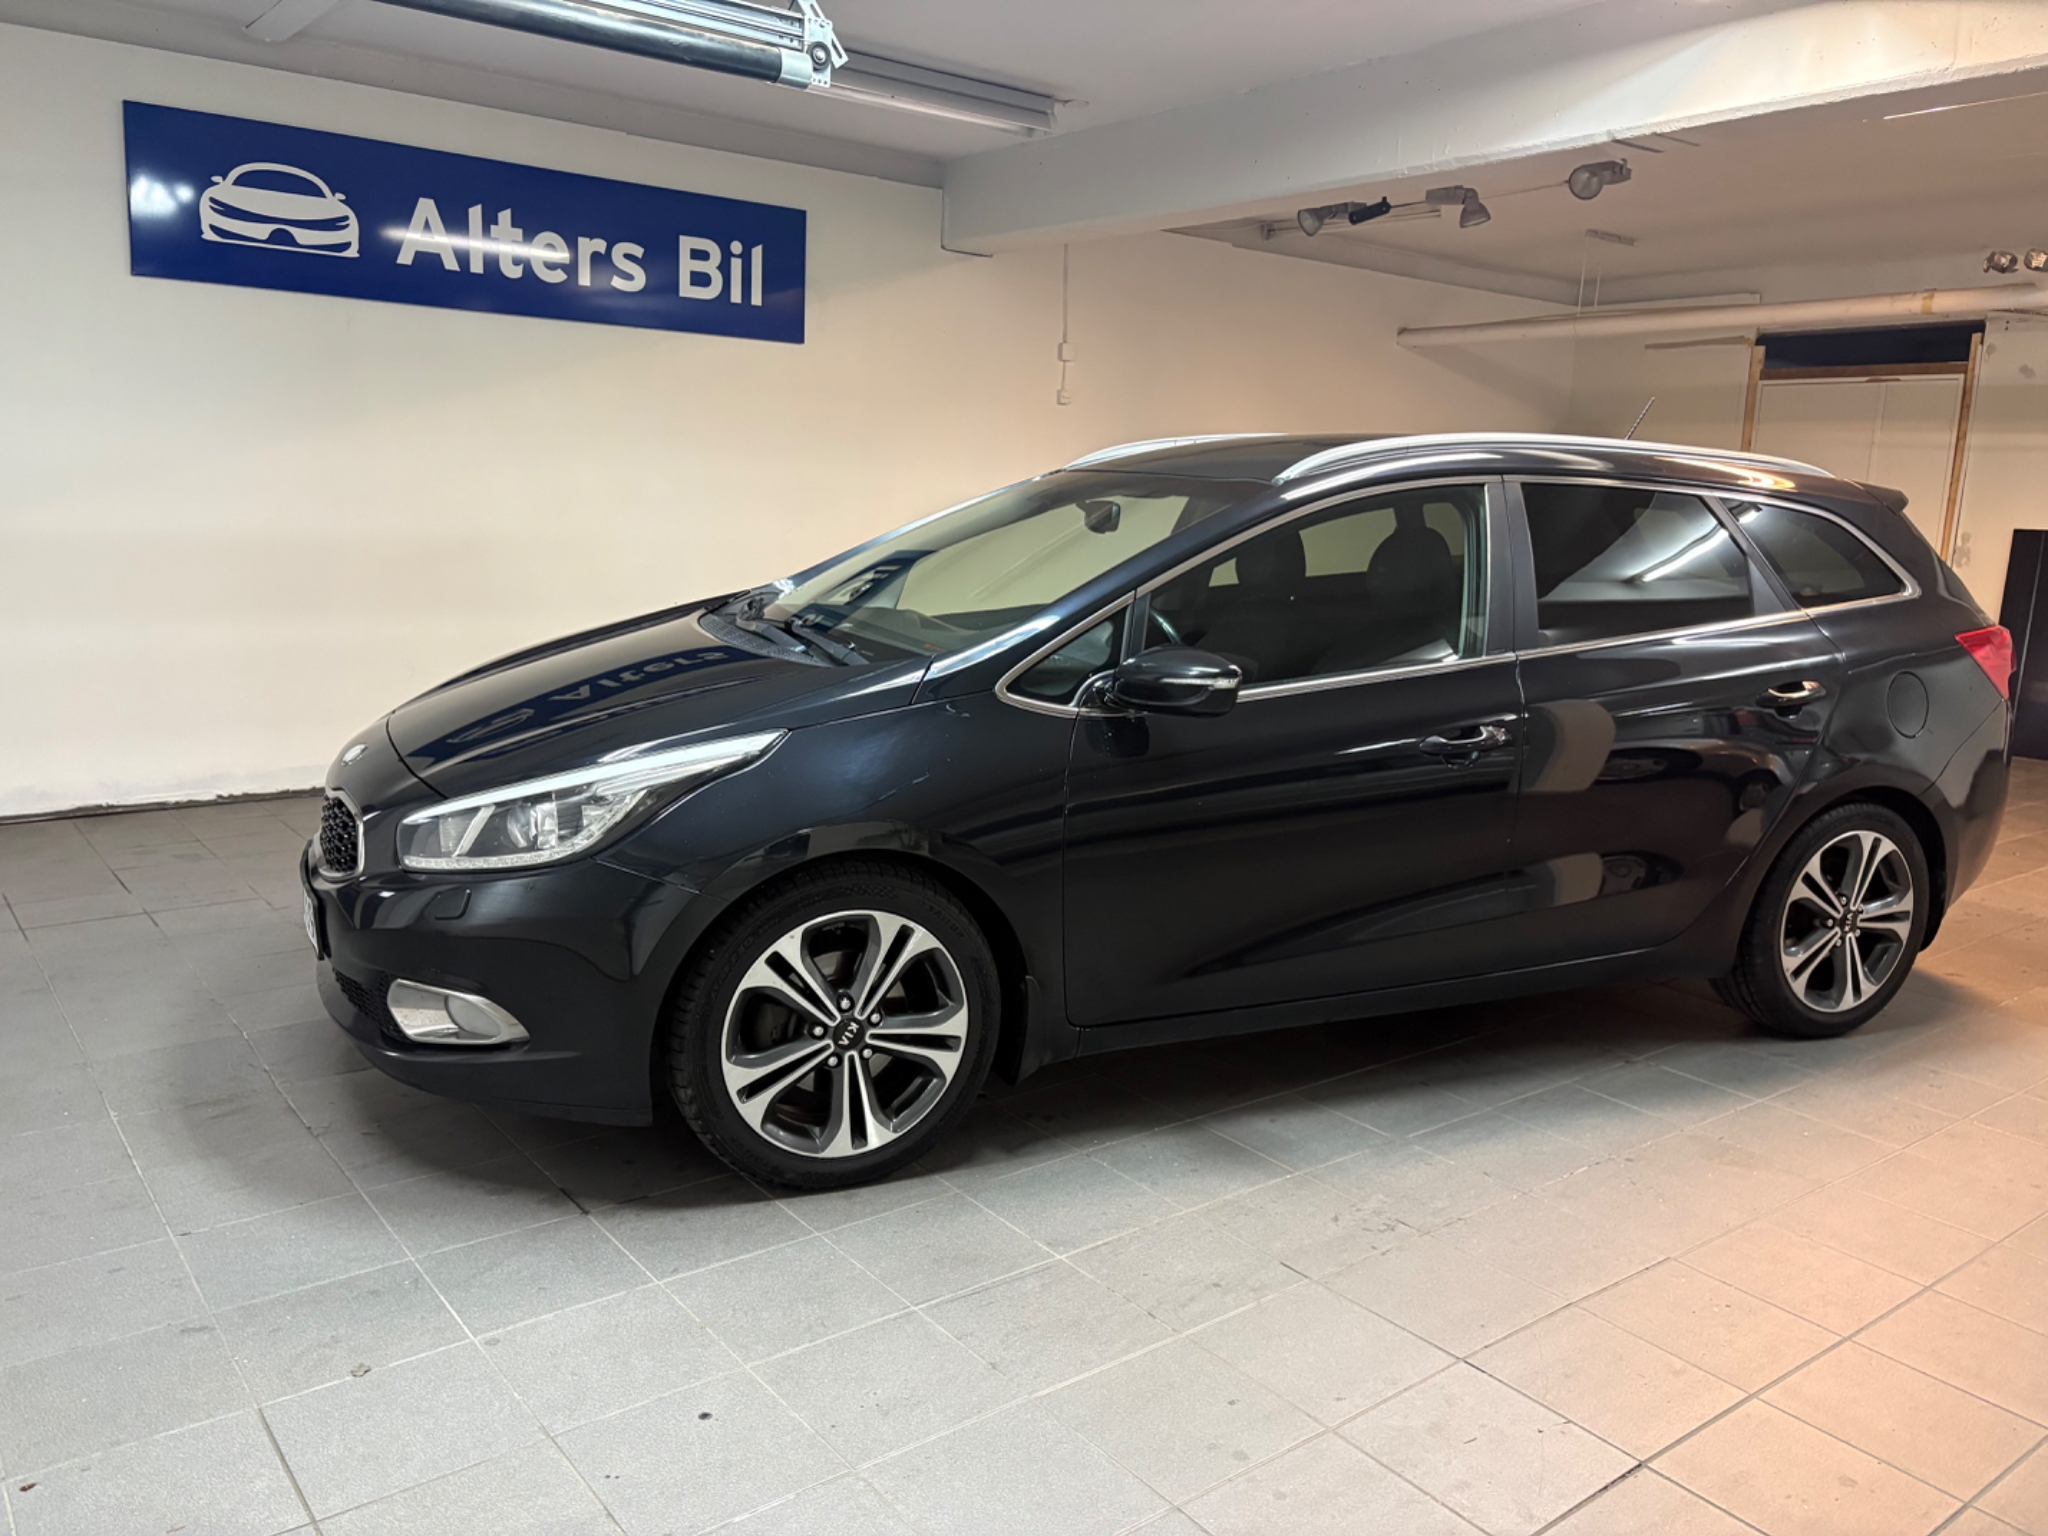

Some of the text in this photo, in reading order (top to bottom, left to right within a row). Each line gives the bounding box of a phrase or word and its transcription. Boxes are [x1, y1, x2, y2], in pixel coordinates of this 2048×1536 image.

[396, 197, 763, 307] Alters Bil
[838, 1021, 859, 1045] KIA
